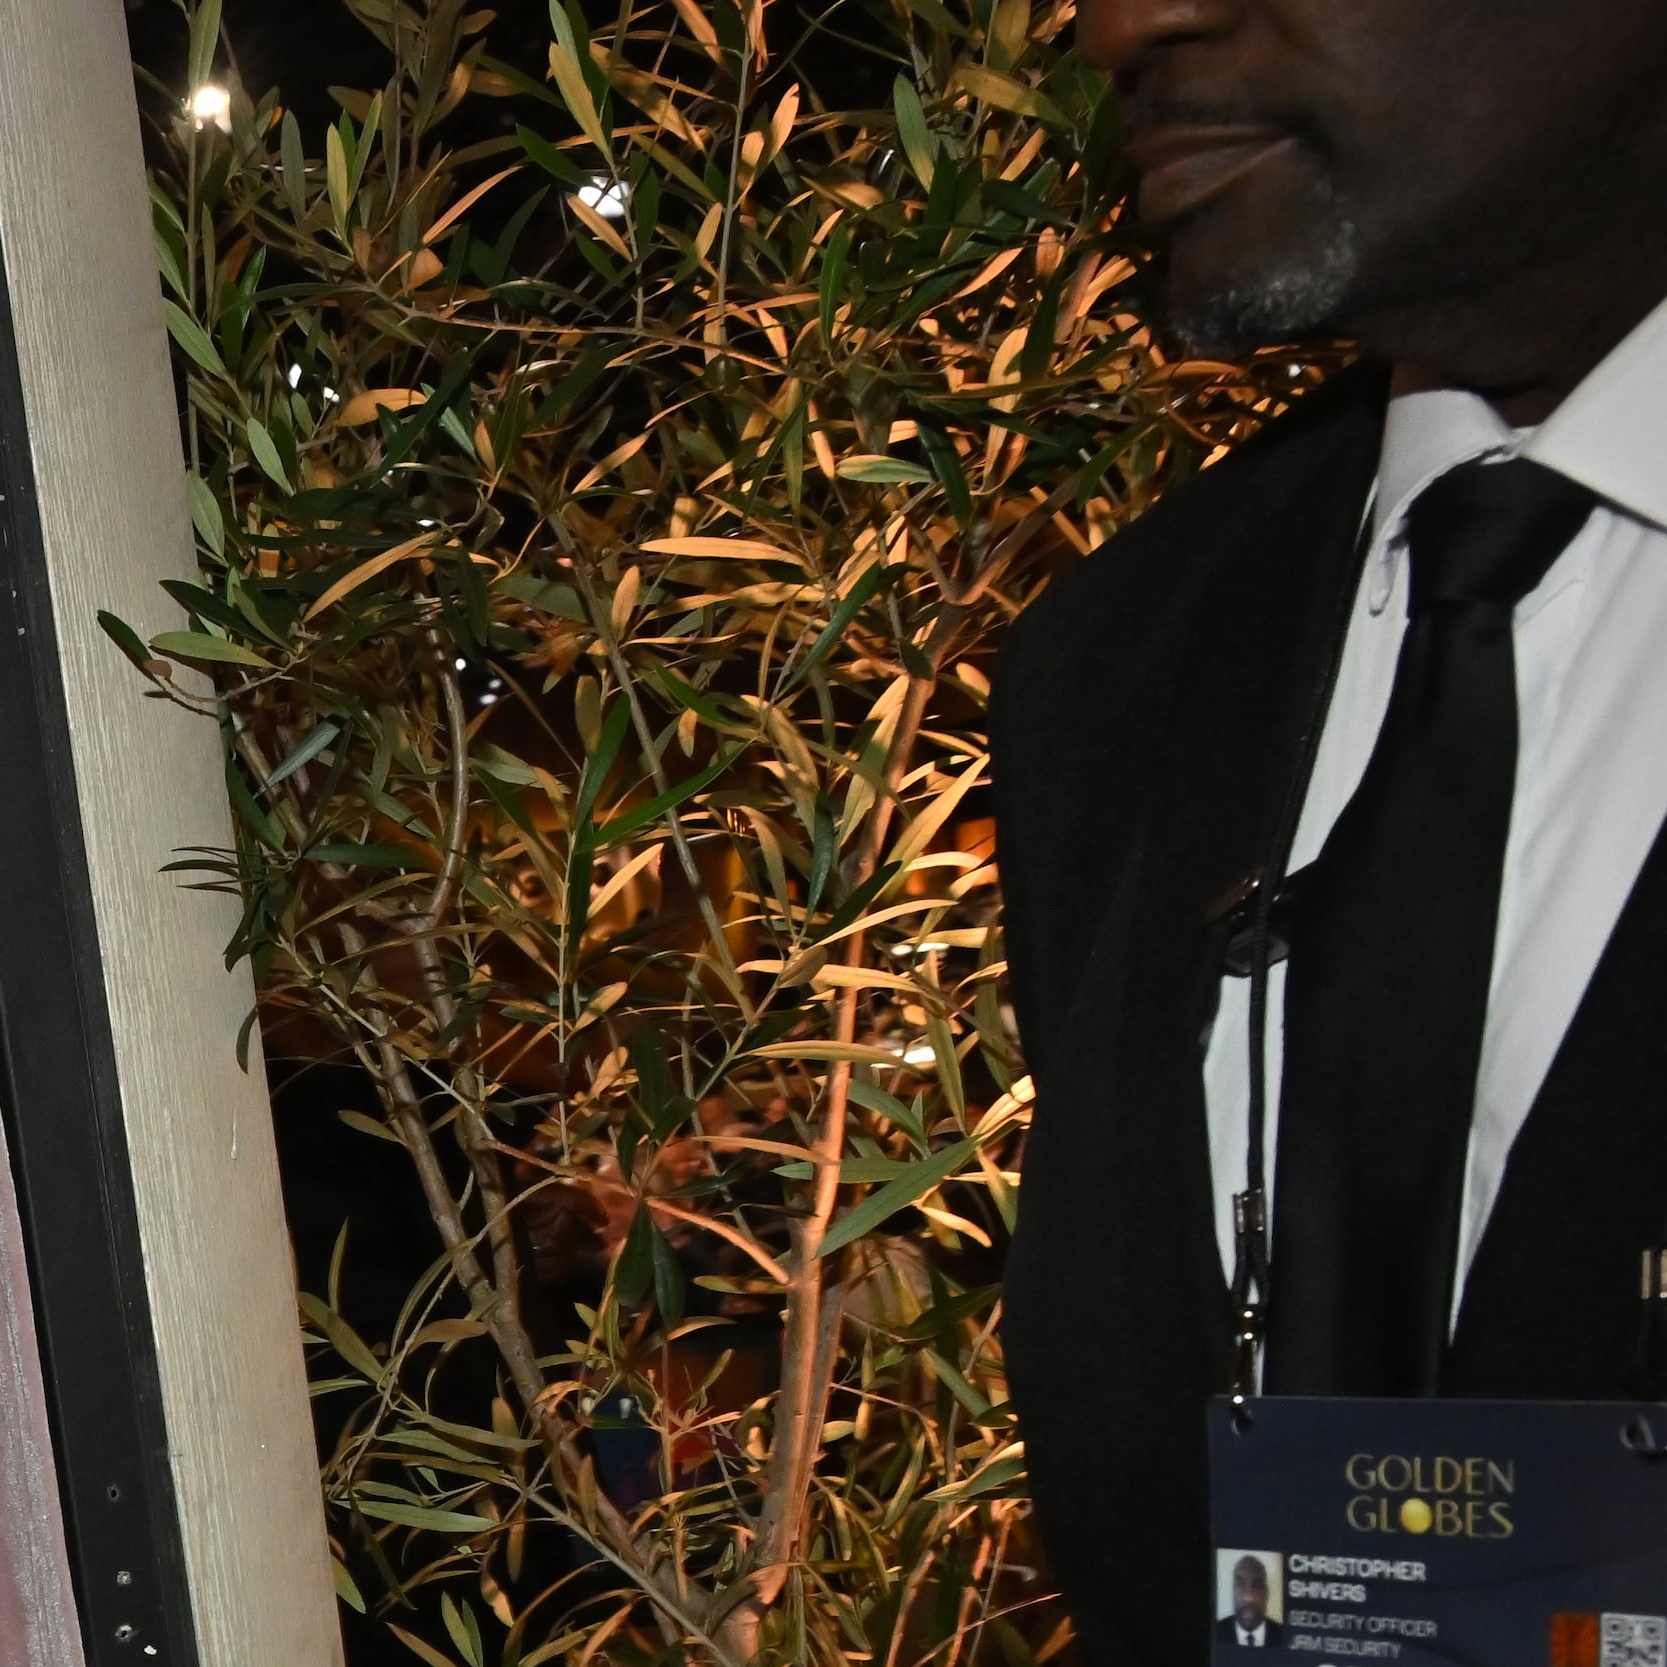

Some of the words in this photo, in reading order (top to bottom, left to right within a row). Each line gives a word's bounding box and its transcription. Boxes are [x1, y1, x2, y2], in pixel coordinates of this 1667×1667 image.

[1345, 1453, 1515, 1495] GOLDEN
[1346, 1495, 1515, 1538] GLOBES
[1288, 1553, 1427, 1582] CHRISTOPHER
[1288, 1579, 1367, 1603] SHIVERS
[1289, 1610, 1366, 1631] SECURITY
[1367, 1616, 1438, 1638] OFFICER
[1325, 1636, 1402, 1659] SECURITY
